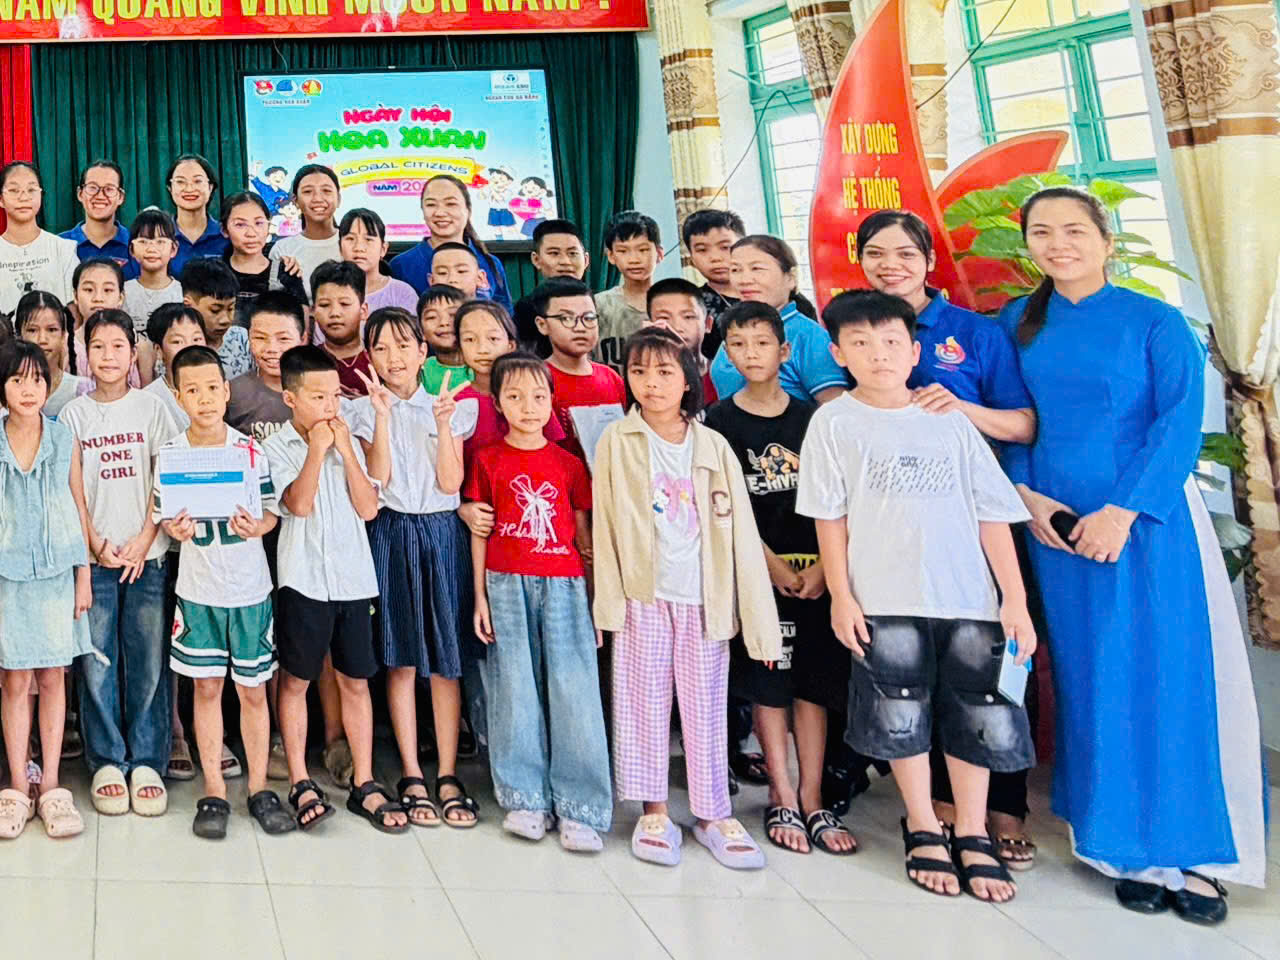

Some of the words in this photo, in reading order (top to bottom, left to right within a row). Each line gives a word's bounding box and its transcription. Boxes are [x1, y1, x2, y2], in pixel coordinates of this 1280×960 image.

[343, 104, 403, 125] NGÀY
[410, 104, 452, 126] HỘI
[840, 117, 862, 155] XÂY
[863, 119, 899, 161] DỰNG
[340, 160, 399, 177] GLOBAL
[402, 160, 469, 175] CITIZENS
[842, 169, 859, 217] HỆ
[859, 165, 902, 210] THỐNG
[82, 431, 145, 451] NUMBER
[100, 448, 133, 463] ONE
[100, 465, 137, 480] GIRL
